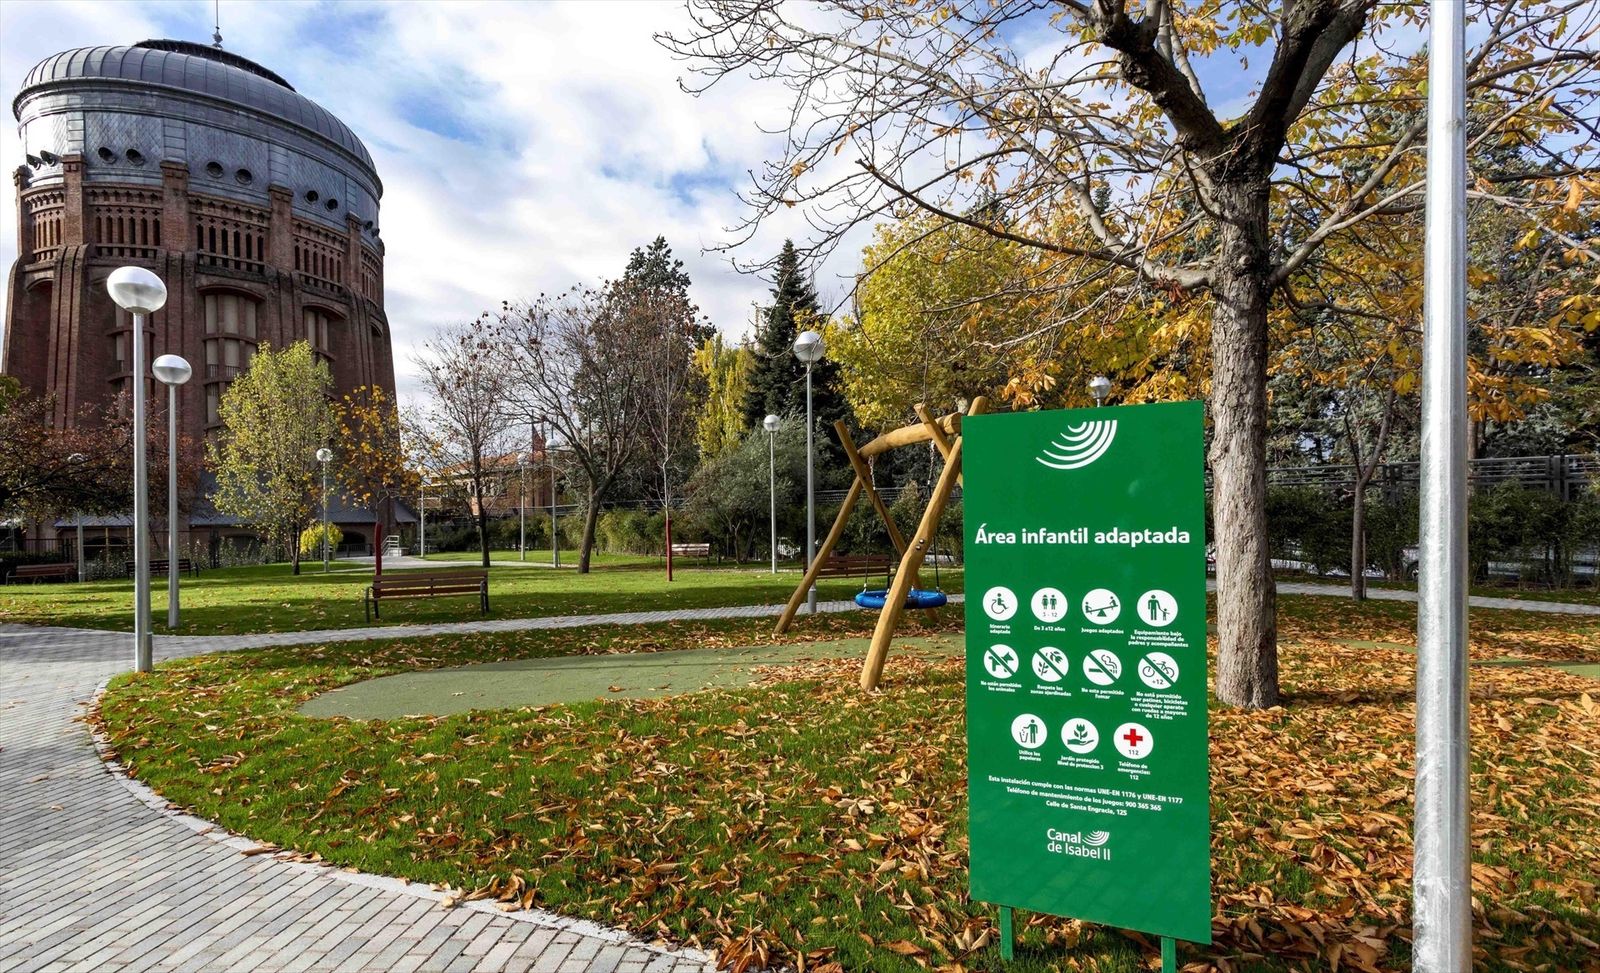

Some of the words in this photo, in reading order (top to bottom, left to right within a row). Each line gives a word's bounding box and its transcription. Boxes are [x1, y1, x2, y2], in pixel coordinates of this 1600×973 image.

[975, 523, 1016, 544] Área
[1022, 527, 1088, 544] infantil
[1094, 526, 1190, 547] adaptada
[1001, 777, 1030, 786] instalación
[1098, 788, 1120, 796] UNE-EN
[1142, 793, 1166, 801] UNE-EN
[1006, 786, 1030, 795] Teléfono
[1040, 791, 1082, 801] mantenimiento
[1102, 798, 1124, 806] juegos:
[1088, 806, 1115, 814] Engracia,
[1046, 828, 1081, 844] Canal
[1047, 841, 1062, 853] de
[1065, 843, 1101, 859] Isabel
[1103, 848, 1111, 861] II
